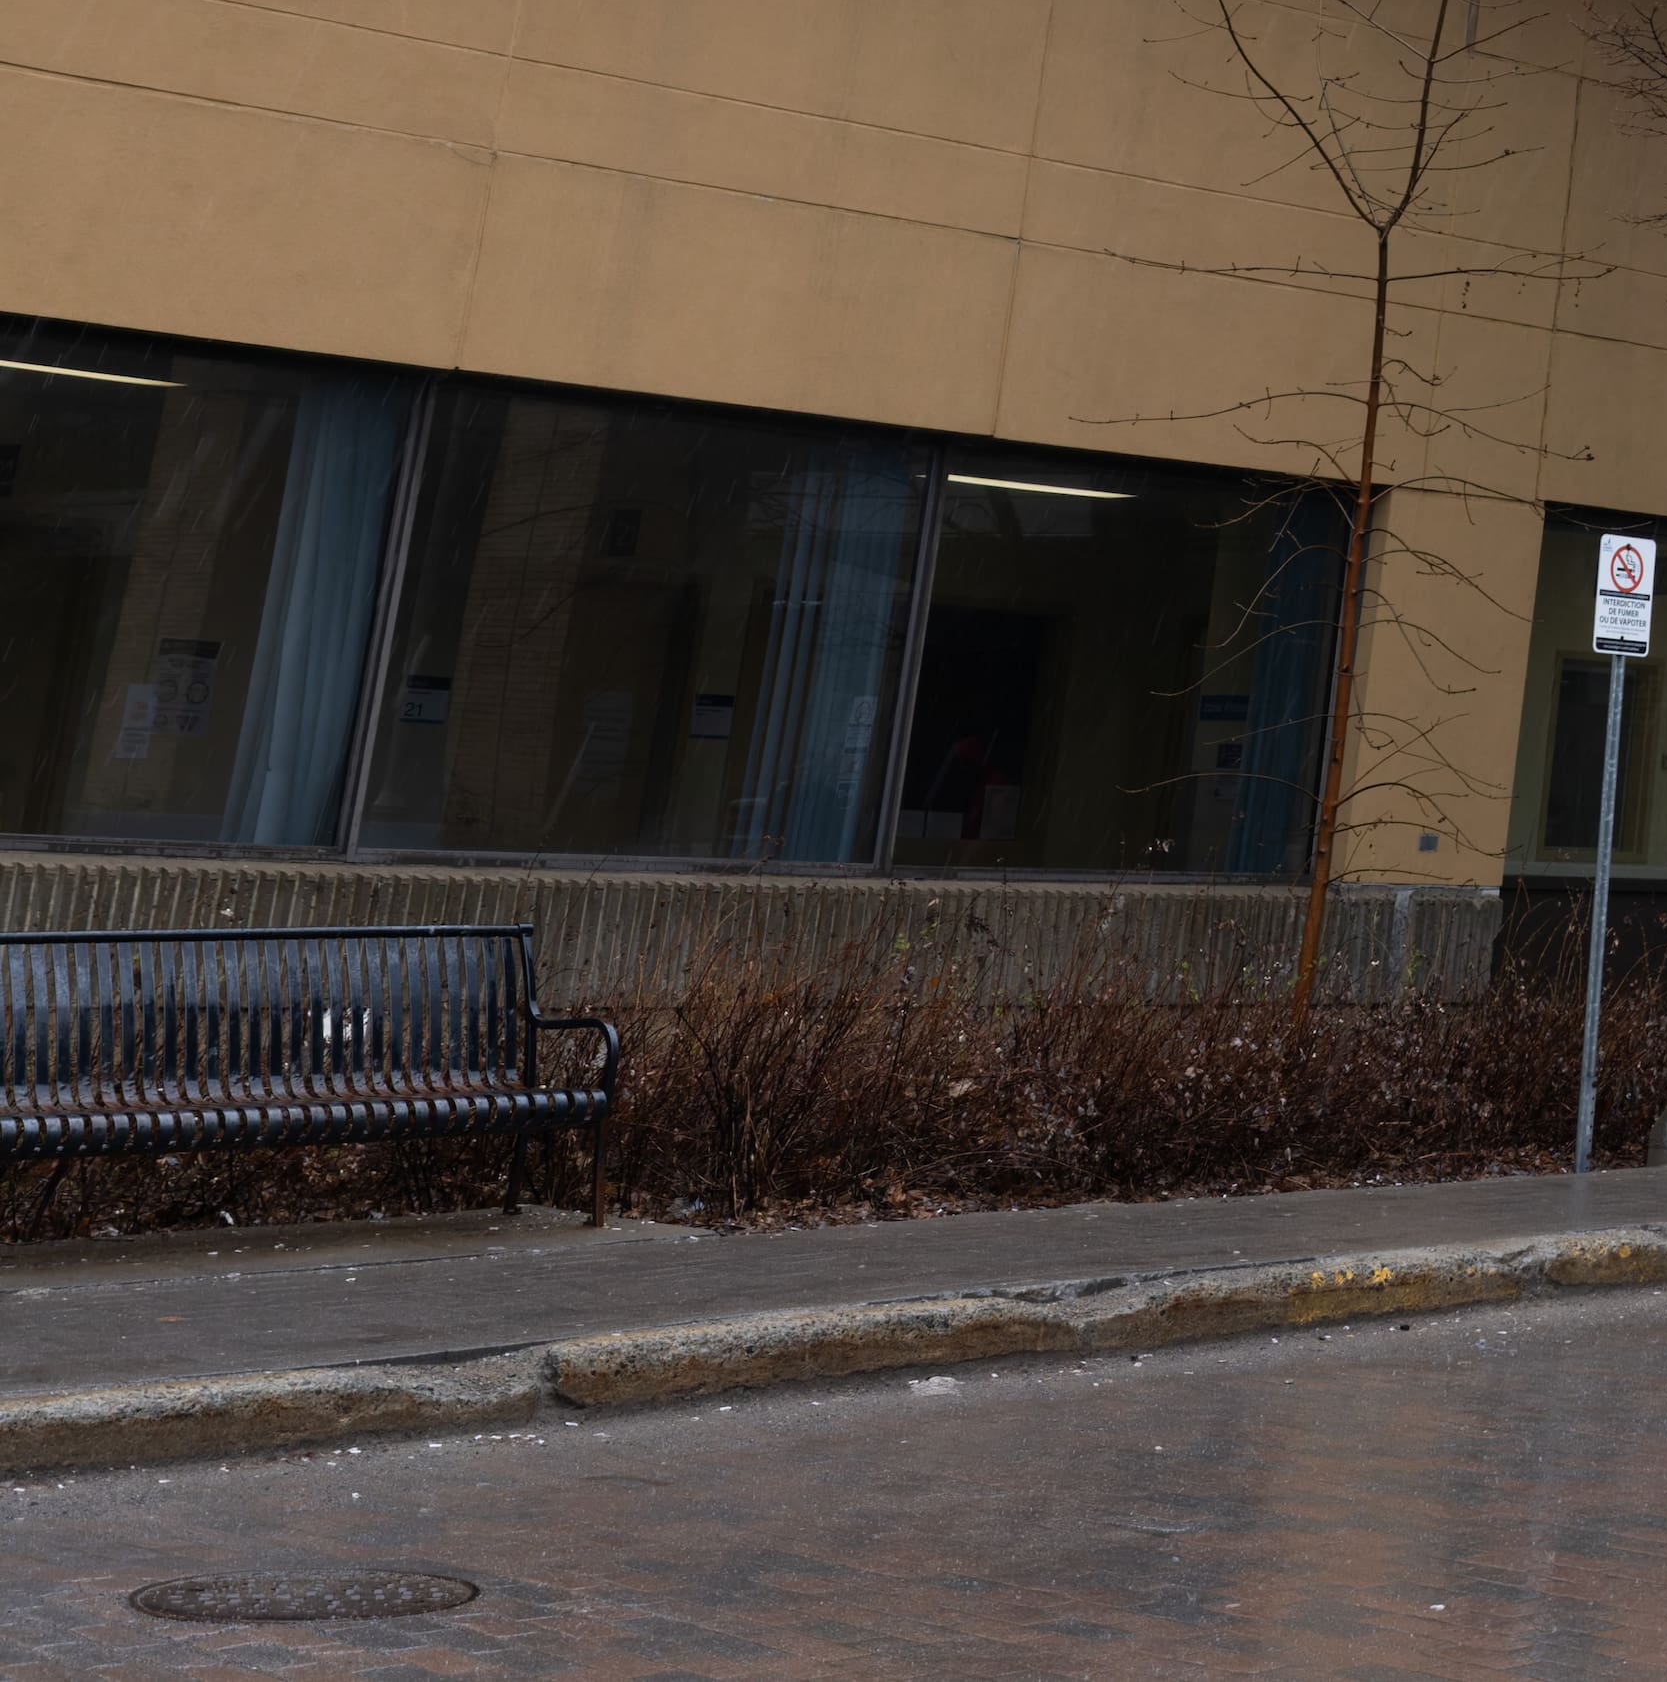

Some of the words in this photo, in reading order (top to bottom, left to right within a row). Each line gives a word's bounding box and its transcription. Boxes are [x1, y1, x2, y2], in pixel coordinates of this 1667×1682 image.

[1603, 598, 1646, 610] INTERDICTION
[1608, 608, 1616, 616] DE
[1618, 608, 1639, 617] FUMER
[1610, 616, 1618, 624] DE
[1619, 617, 1647, 627] VAPOTER
[404, 702, 423, 717] 21
